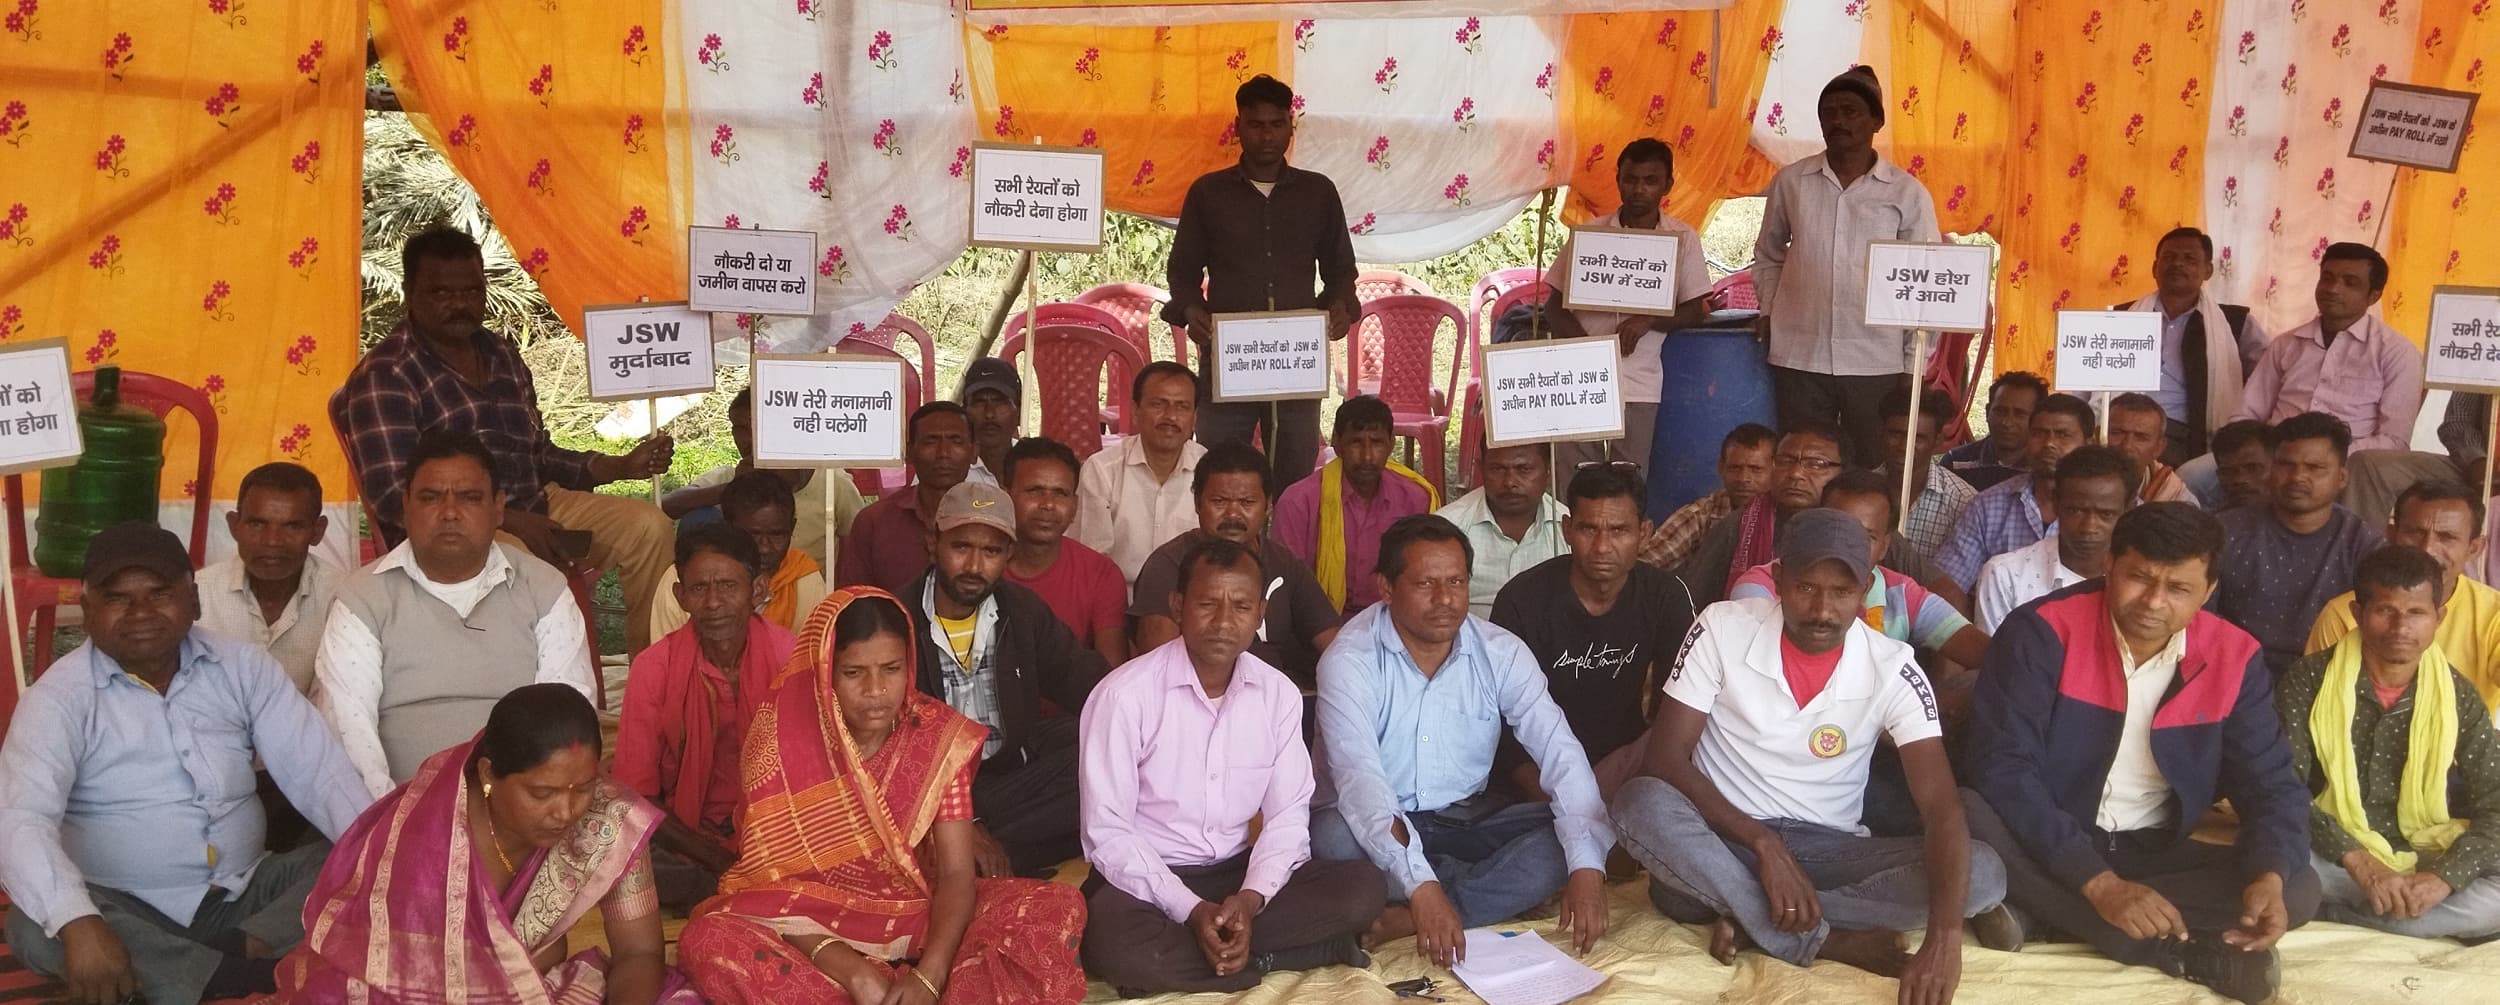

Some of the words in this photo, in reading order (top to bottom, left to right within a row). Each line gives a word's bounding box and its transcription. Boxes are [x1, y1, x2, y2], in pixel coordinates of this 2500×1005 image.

[2388, 126, 2405, 138] PAY
[2405, 128, 2425, 142] ROLL
[994, 174, 1023, 193] सभी
[1026, 176, 1061, 196] रैयतों
[1062, 178, 1080, 197] को
[985, 198, 1025, 218] नौकरी
[1029, 200, 1055, 219] देना
[1057, 202, 1088, 221] होगा
[714, 250, 756, 271] नौकरी
[758, 252, 773, 271] दो
[776, 259, 792, 272] या
[1579, 253, 1608, 267] सभी
[1611, 255, 1647, 271] रैयतों
[1648, 260, 1668, 272] को
[698, 270, 739, 290] जमीन
[742, 278, 778, 293] वापस
[781, 276, 806, 294] करो
[1580, 271, 1614, 285] JSW
[1618, 273, 1633, 286] में
[1634, 276, 1662, 289] रखो
[1886, 267, 1930, 283] JSW
[1934, 268, 1971, 286] होश
[1895, 285, 1914, 301] में
[1915, 287, 1957, 303] आवो
[617, 322, 680, 345] JSW
[2452, 318, 2481, 337] सभी
[2484, 319, 2500, 338] रैय
[1225, 343, 1241, 354] JSW
[1243, 340, 1258, 354] सभी
[1260, 340, 1279, 353] रैयतों
[1280, 340, 1290, 353] को
[1294, 341, 1310, 352] JSW
[1311, 338, 1319, 351] के
[2062, 334, 2087, 348] JSW
[2090, 332, 2107, 350] तेरी
[2110, 334, 2154, 351] मनामानी
[2440, 340, 2482, 361] नौकरी
[608, 347, 692, 378] मुर्दाबाद
[1228, 358, 1249, 372] अधीन
[1251, 359, 1267, 371] PAY
[1269, 357, 1291, 370] ROLL
[1293, 356, 1302, 369] में
[1302, 355, 1316, 369] रखो
[2082, 351, 2102, 369] नही
[2105, 352, 2136, 369] चलेगी
[1497, 377, 1515, 390] JSW
[1518, 372, 1535, 390] सभी
[1537, 371, 1559, 388] रैयतों
[1561, 370, 1573, 388] को
[1578, 371, 1597, 384] JSW
[1599, 367, 1609, 382] के
[15, 381, 41, 404] को
[764, 390, 798, 407] JSW
[802, 388, 827, 409] तेरी
[830, 390, 893, 410] मनामानी
[1502, 394, 1527, 411] अधीन
[1529, 394, 1547, 408] PAY
[1551, 391, 1577, 407] ROLL
[1579, 390, 1588, 405] में
[1588, 388, 1607, 405] रखो
[15, 411, 58, 435] होगा
[793, 411, 822, 433] नही
[825, 413, 868, 433] चलेगी
[1902, 666, 1936, 718] JBKSS
